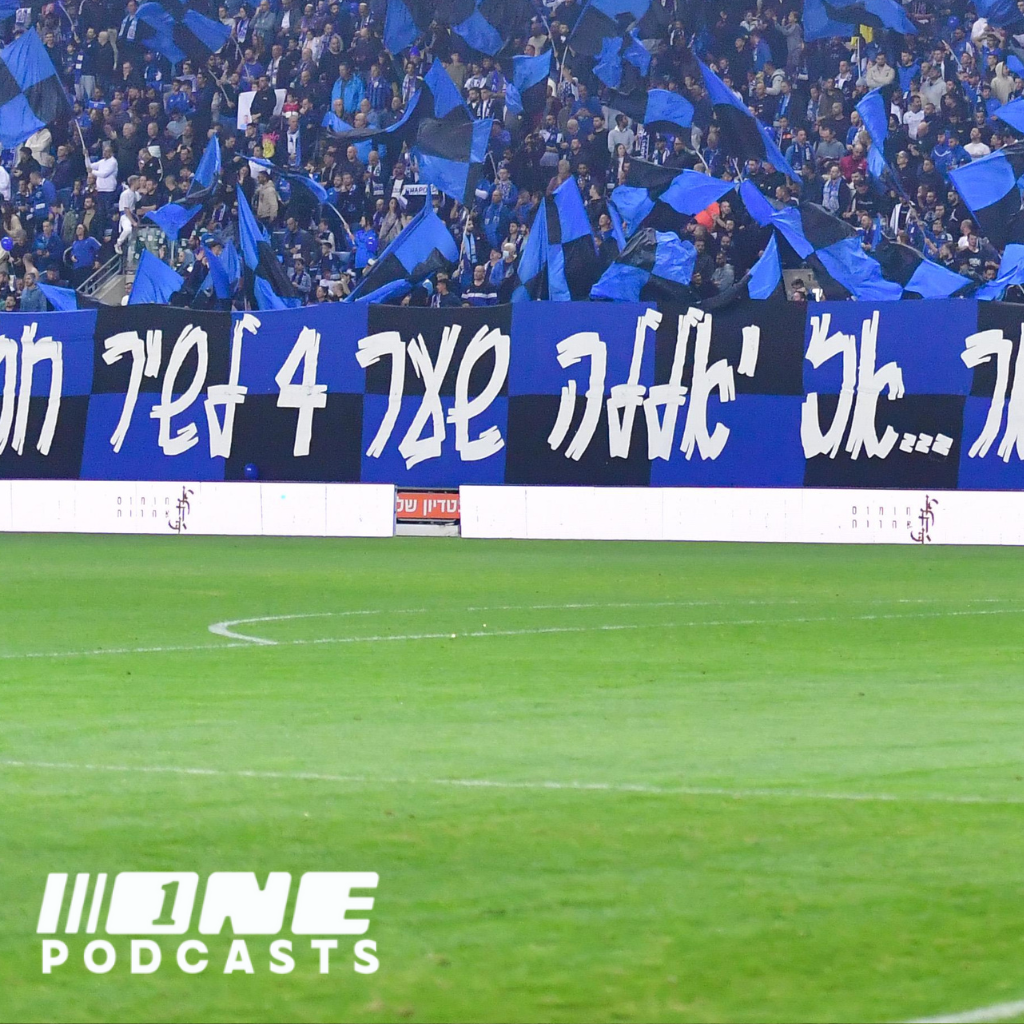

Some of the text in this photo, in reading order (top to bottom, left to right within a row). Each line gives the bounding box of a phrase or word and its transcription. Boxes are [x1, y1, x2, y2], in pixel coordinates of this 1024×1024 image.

[102, 314, 260, 458] לשיר
[275, 326, 327, 456] 4
[356, 325, 510, 469] שער
[548, 307, 759, 460] יאללה
[423, 499, 460, 516] טדיון
